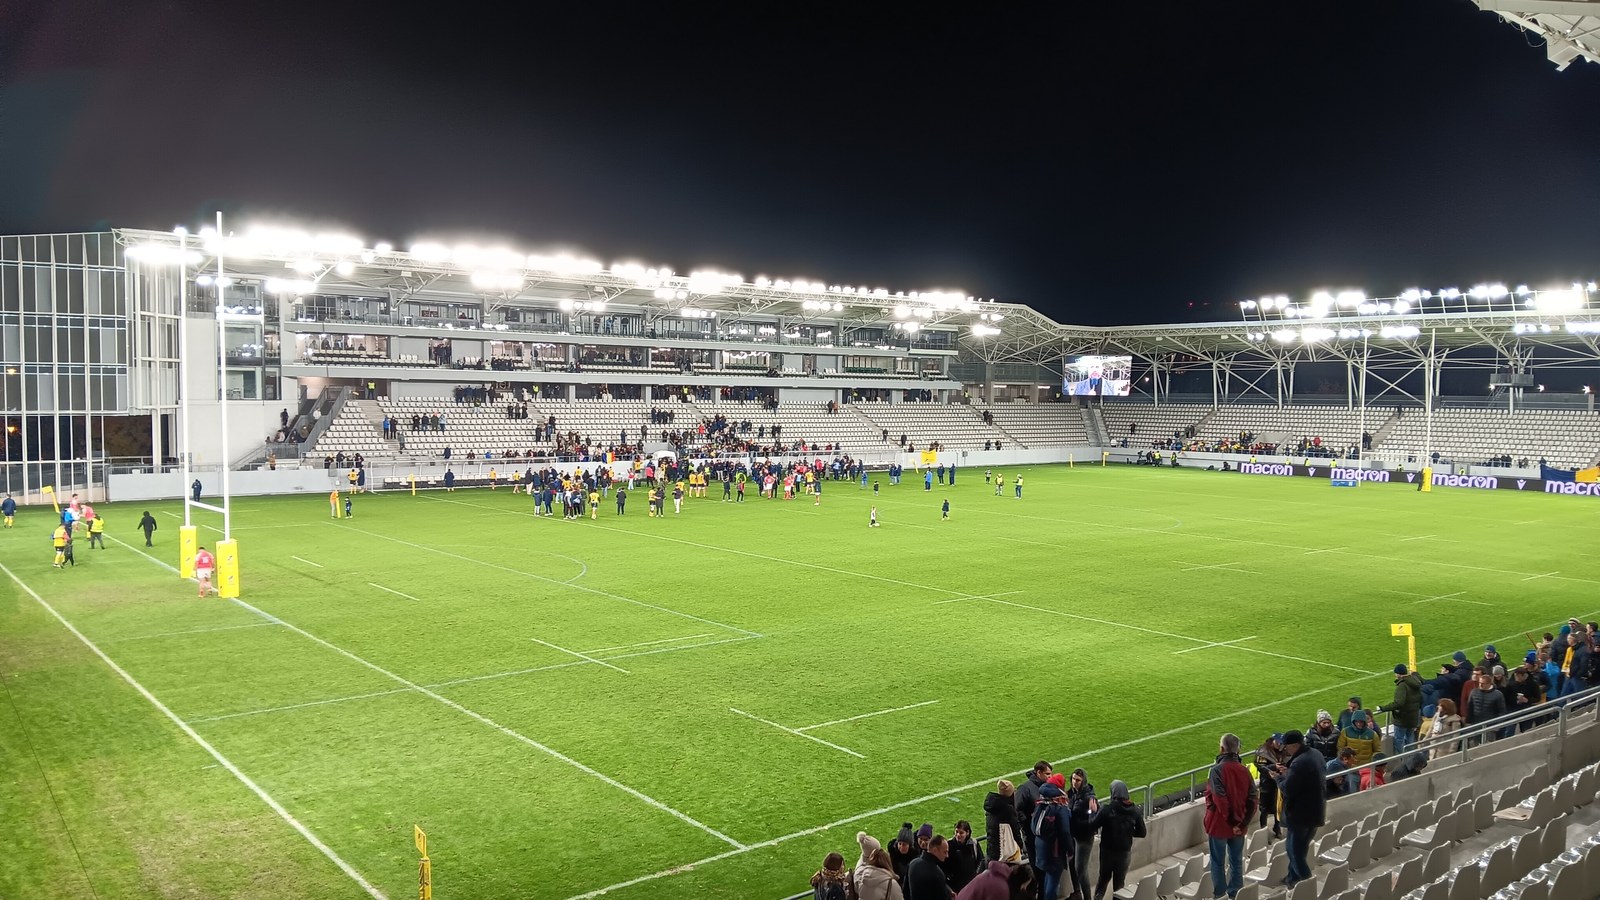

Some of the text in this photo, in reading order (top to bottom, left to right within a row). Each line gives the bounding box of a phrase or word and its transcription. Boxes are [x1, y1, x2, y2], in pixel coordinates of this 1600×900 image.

[1240, 462, 1293, 476] macron
[1331, 468, 1390, 482] macron
[1431, 473, 1498, 489] macron
